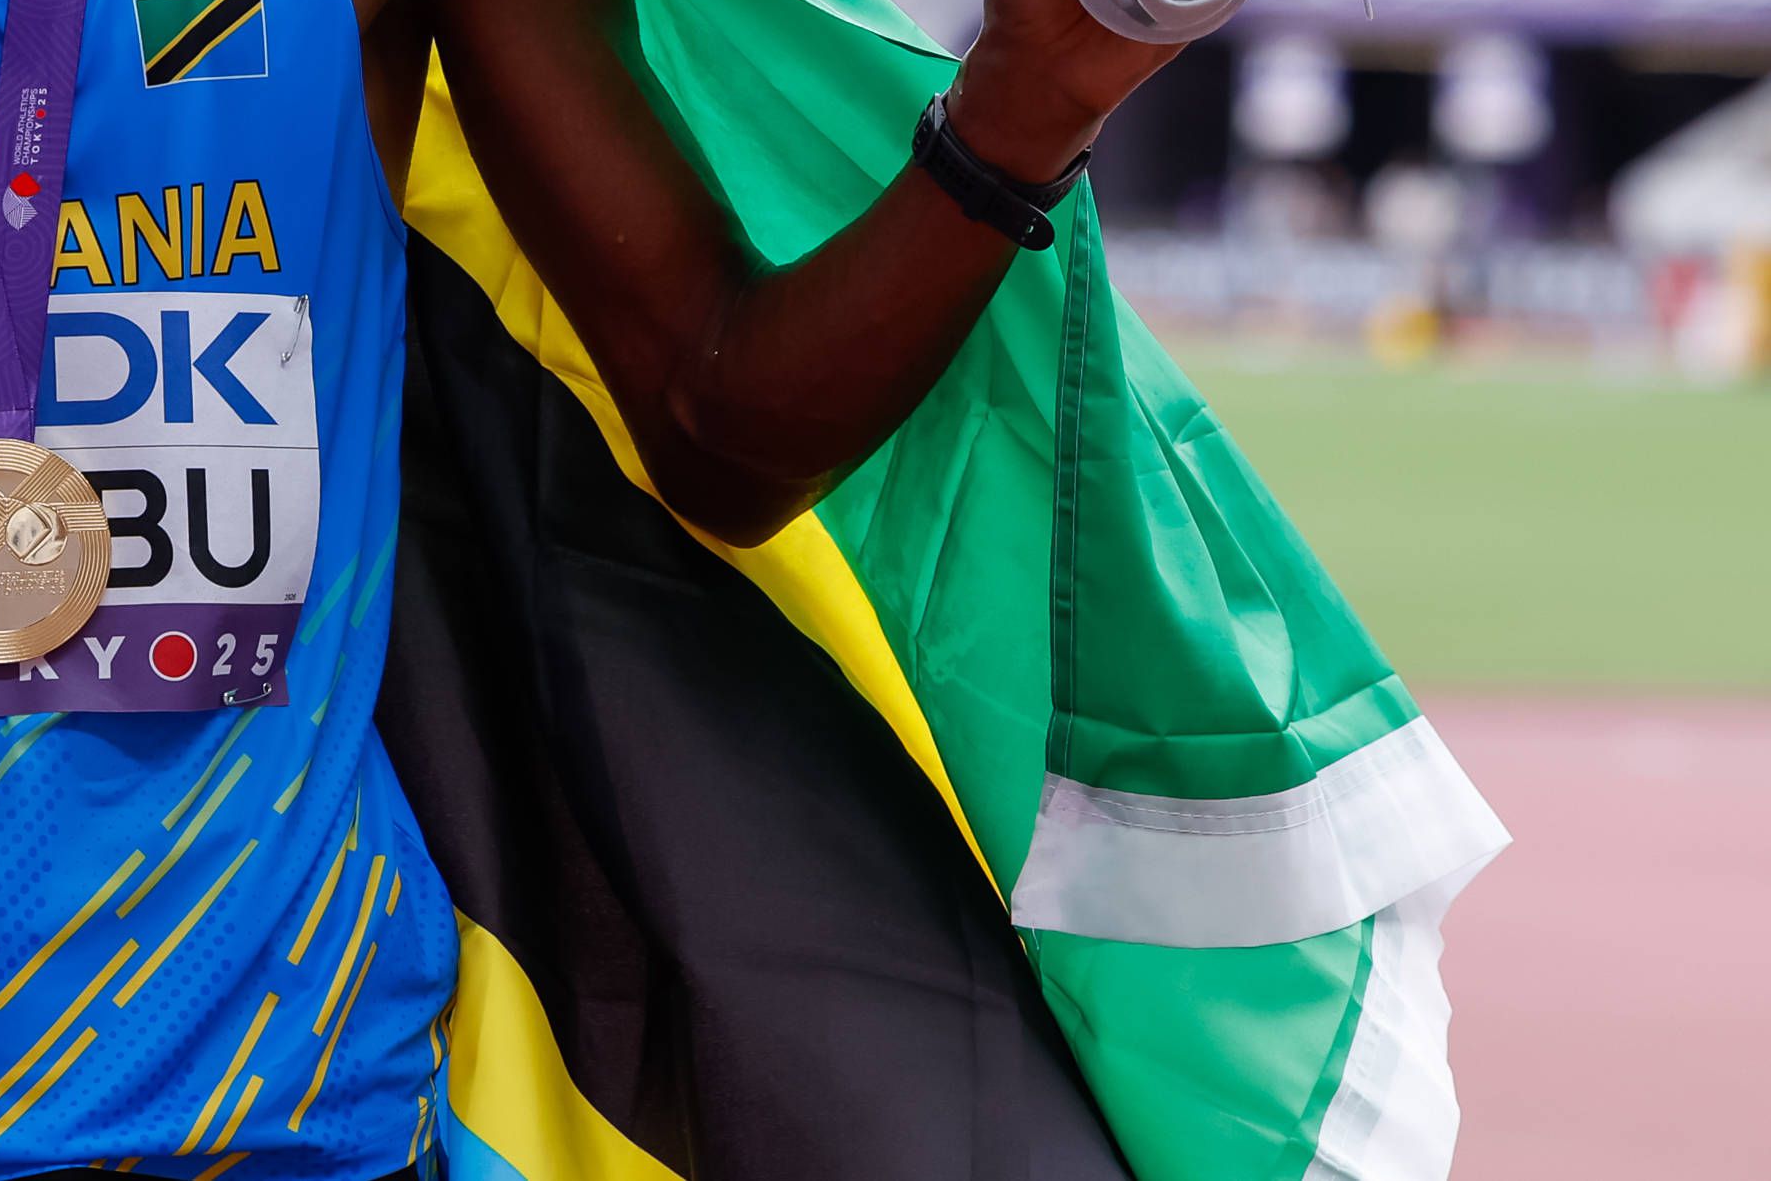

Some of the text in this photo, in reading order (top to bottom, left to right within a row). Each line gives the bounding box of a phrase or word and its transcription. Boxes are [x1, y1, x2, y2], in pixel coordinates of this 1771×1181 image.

[13, 87, 30, 165] WORLD ATHLETICS
[21, 87, 38, 166] CHAMPIONSHIPS
